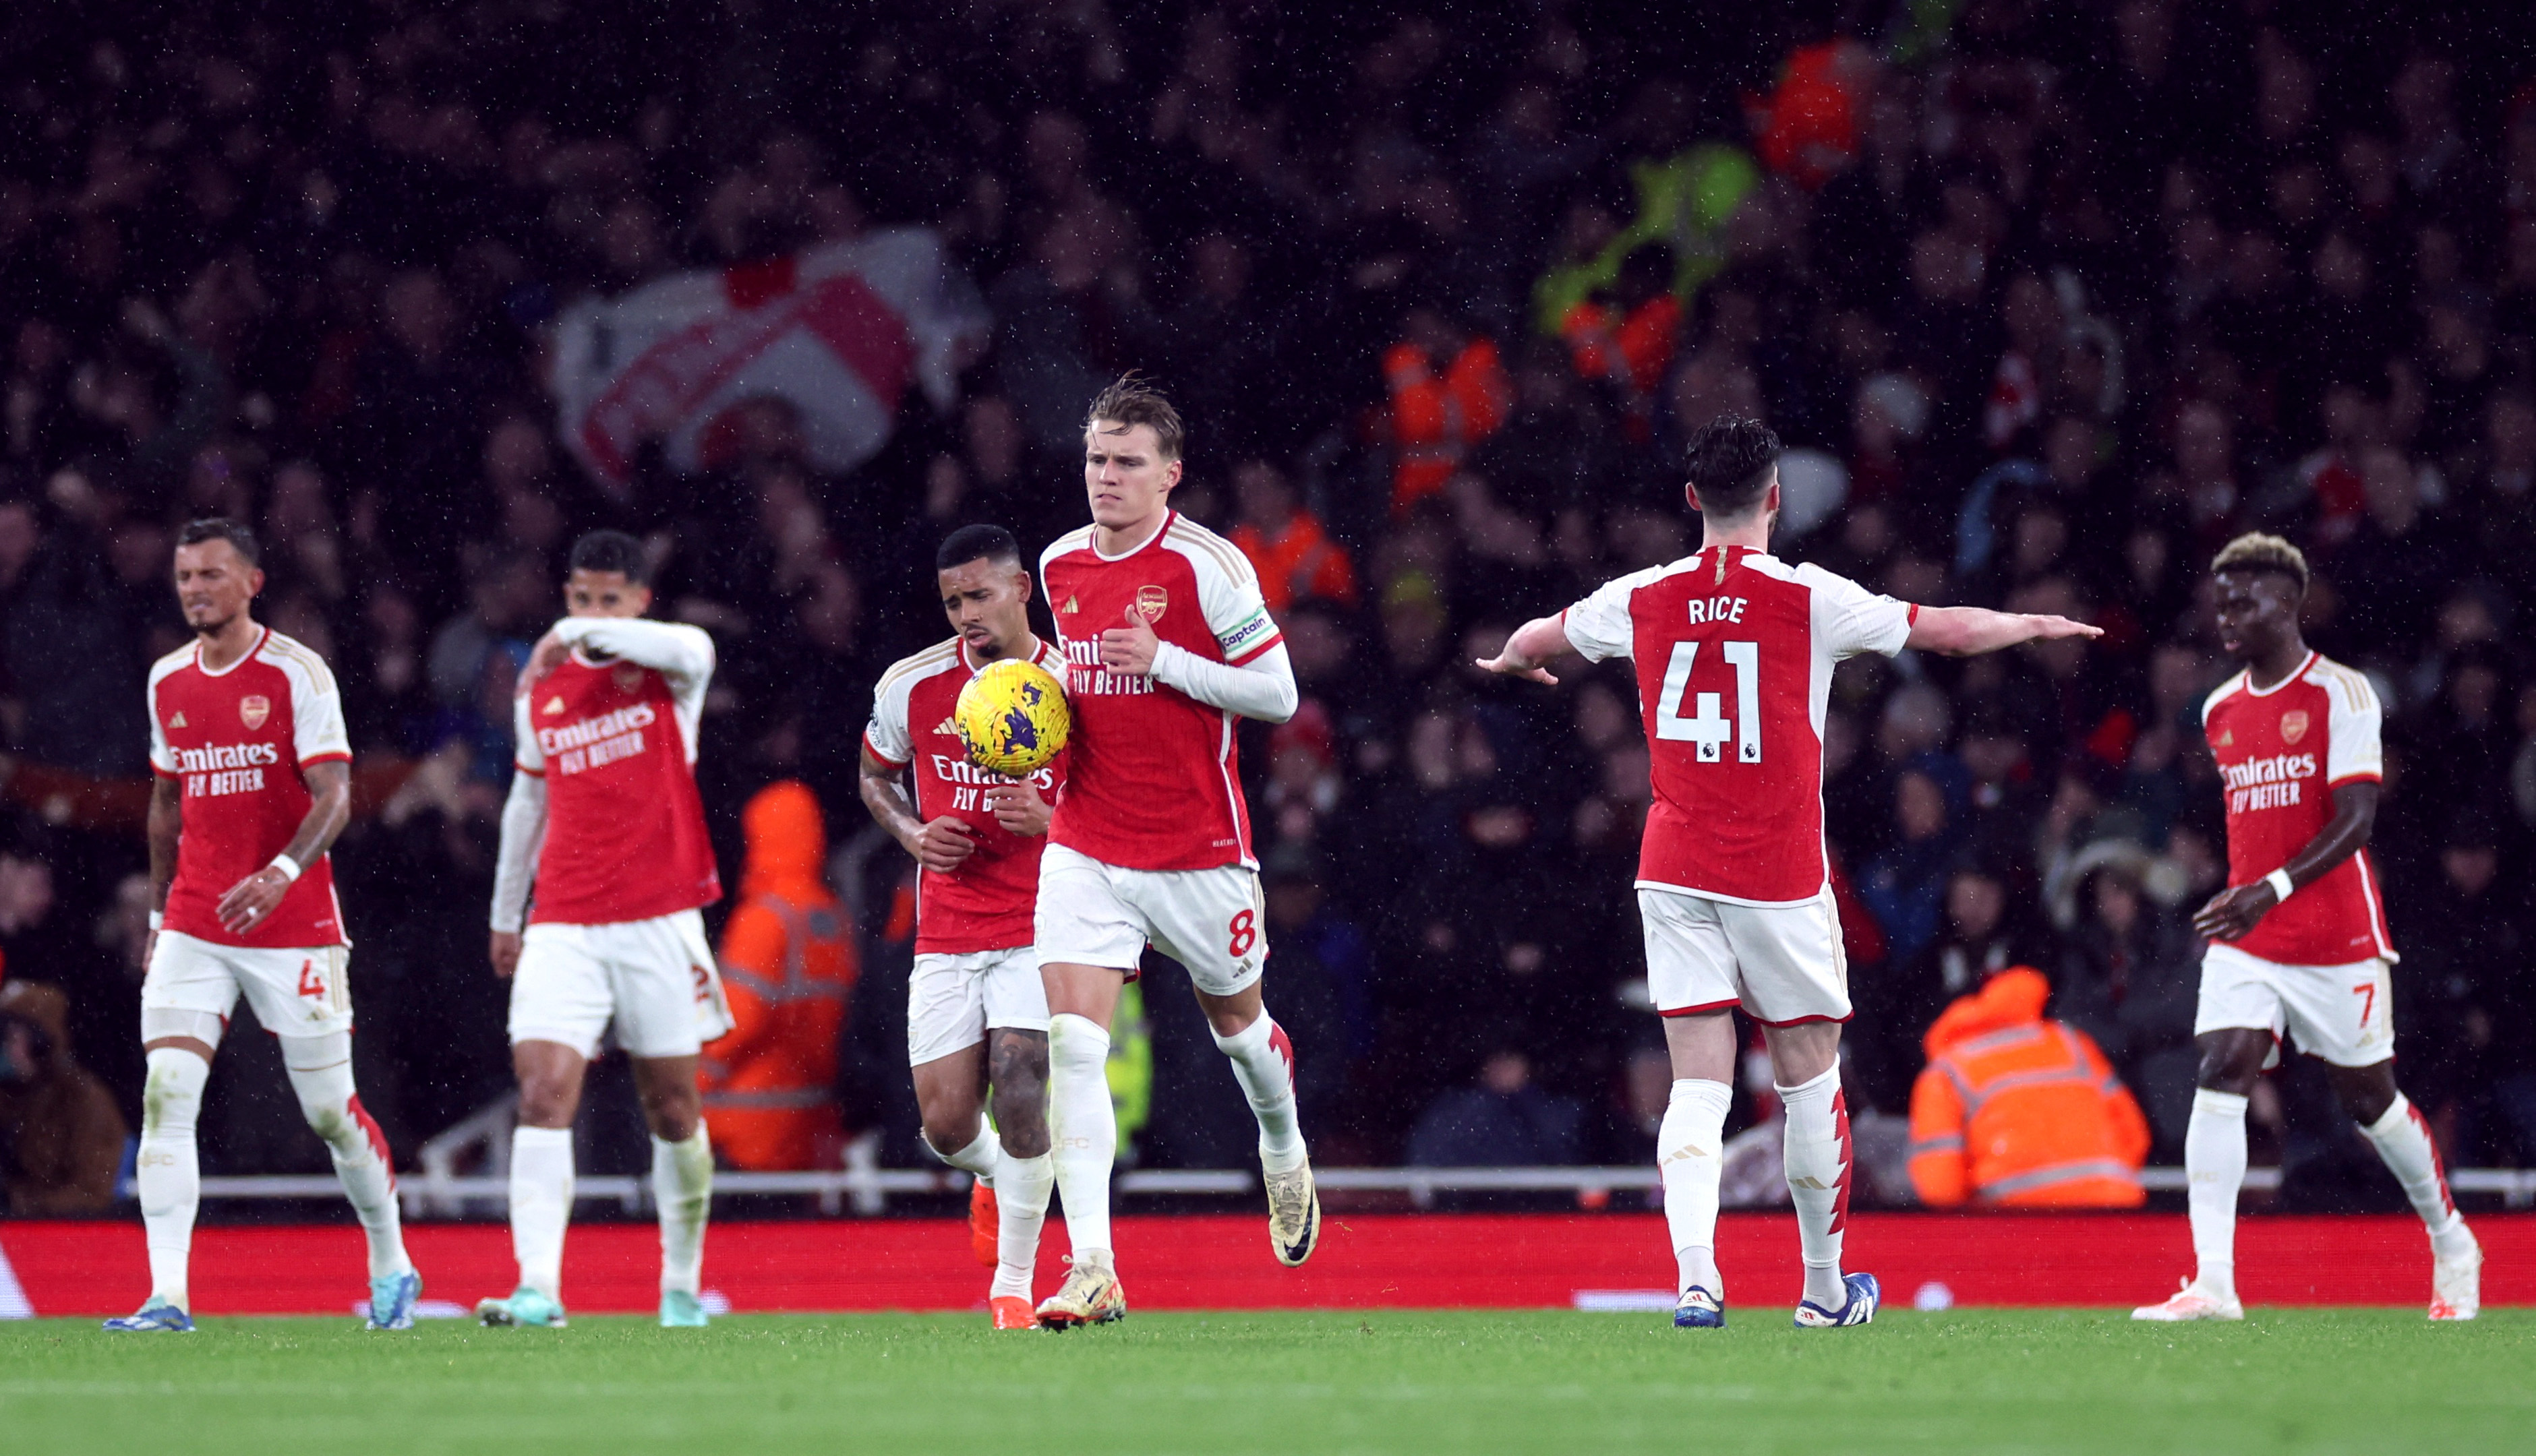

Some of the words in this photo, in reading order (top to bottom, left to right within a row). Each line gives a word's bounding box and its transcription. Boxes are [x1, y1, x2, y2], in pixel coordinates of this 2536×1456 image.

[1688, 596, 1748, 625] RICE
[1222, 617, 1266, 647] Captain
[1071, 669, 1091, 694] FLY
[1655, 641, 1761, 763] 41
[952, 786, 979, 812] FLY
[1229, 909, 1256, 958] 8
[297, 959, 325, 1000] 4
[2353, 982, 2376, 1030] 7
